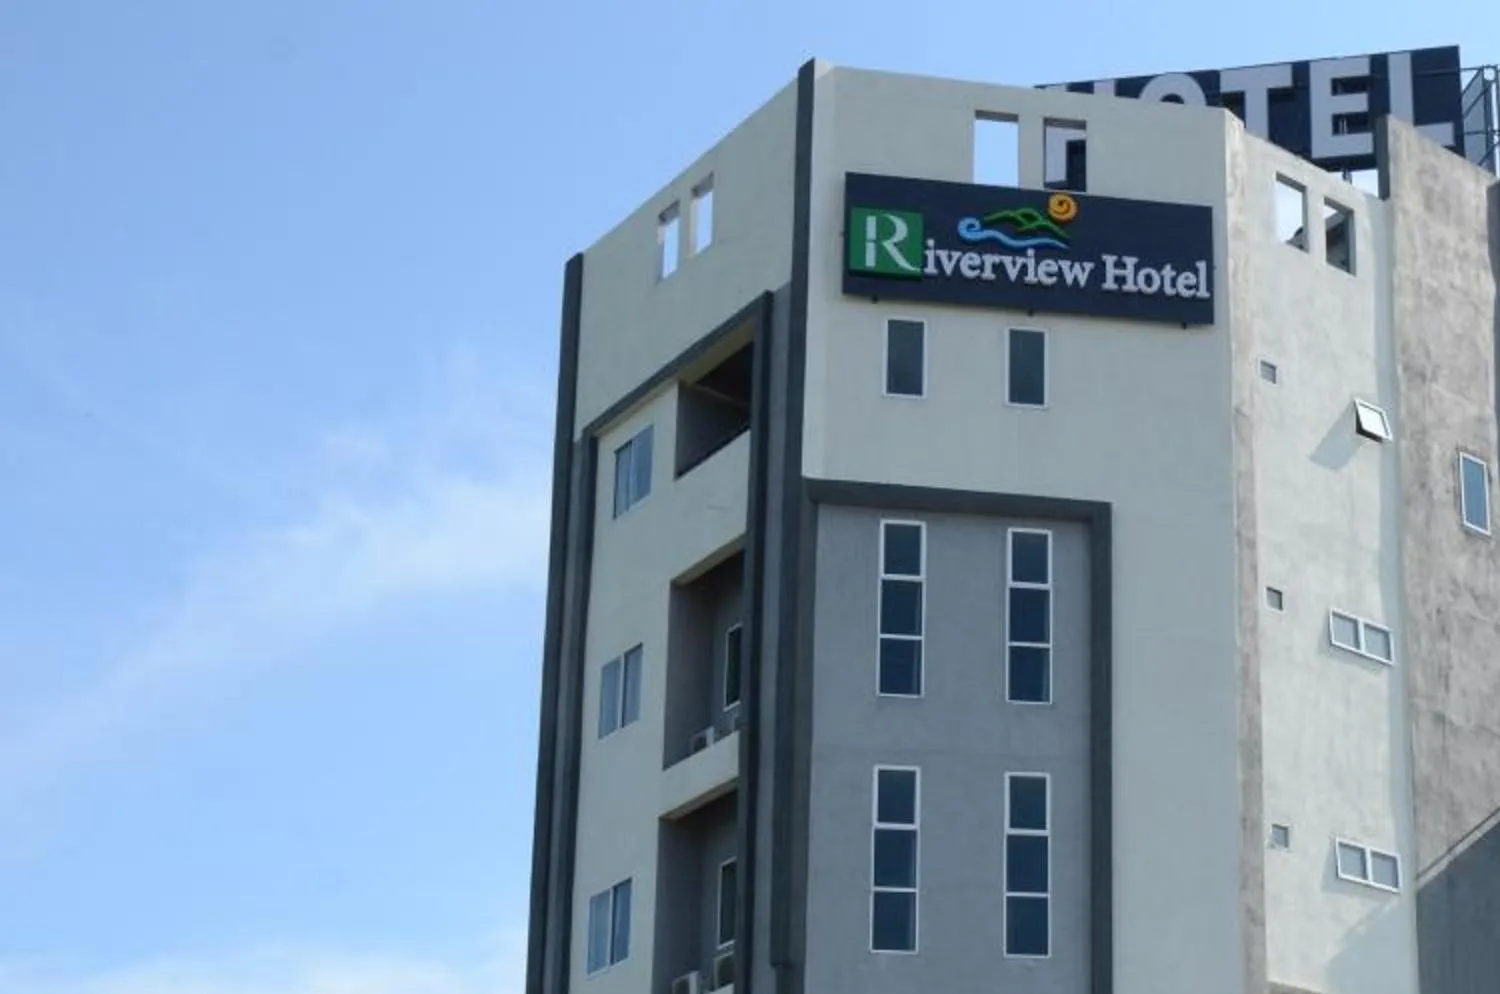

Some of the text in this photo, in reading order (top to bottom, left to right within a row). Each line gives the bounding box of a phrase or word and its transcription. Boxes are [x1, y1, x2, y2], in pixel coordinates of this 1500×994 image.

[1050, 51, 1455, 163] TEL
[864, 213, 1211, 299] Riverview Hotel
